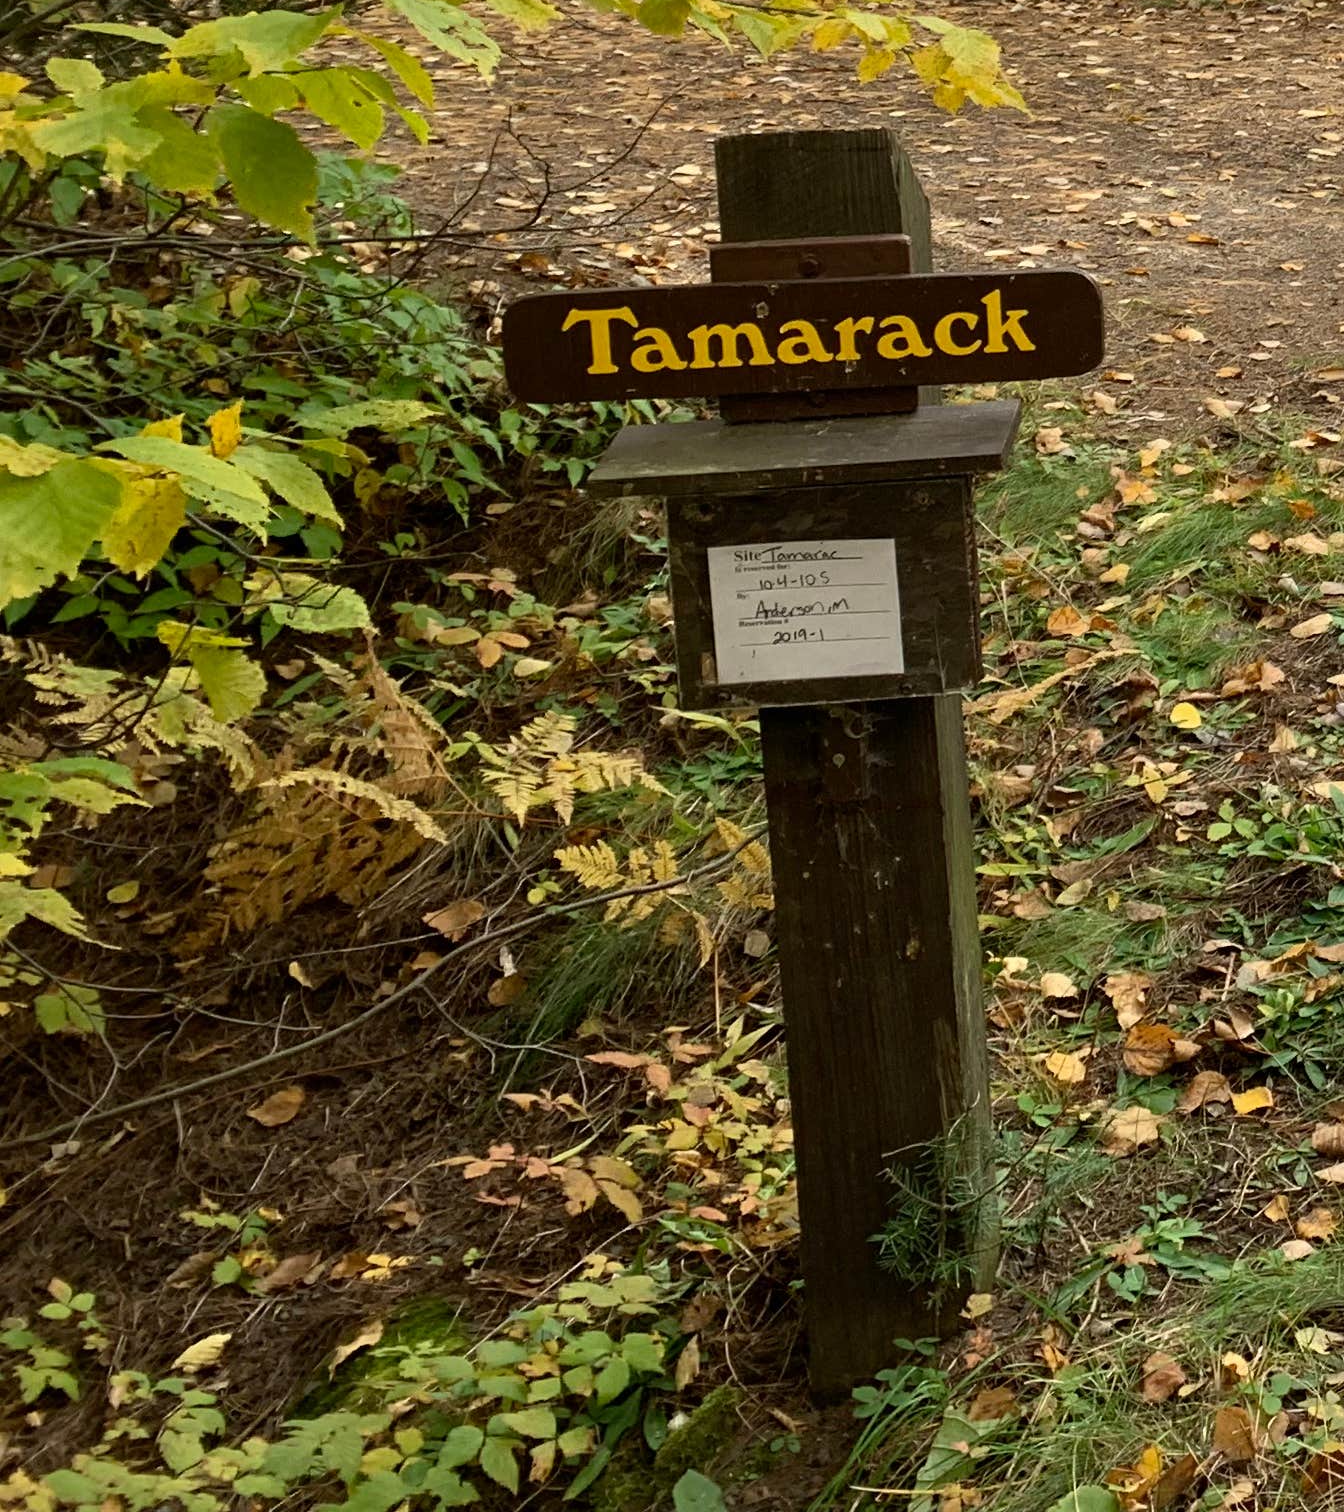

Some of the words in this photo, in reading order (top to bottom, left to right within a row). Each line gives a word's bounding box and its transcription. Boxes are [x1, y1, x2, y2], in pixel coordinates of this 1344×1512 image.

[561, 288, 1036, 375] Tamarack
[734, 550, 761, 562] Site
[738, 619, 783, 628] Reservation
